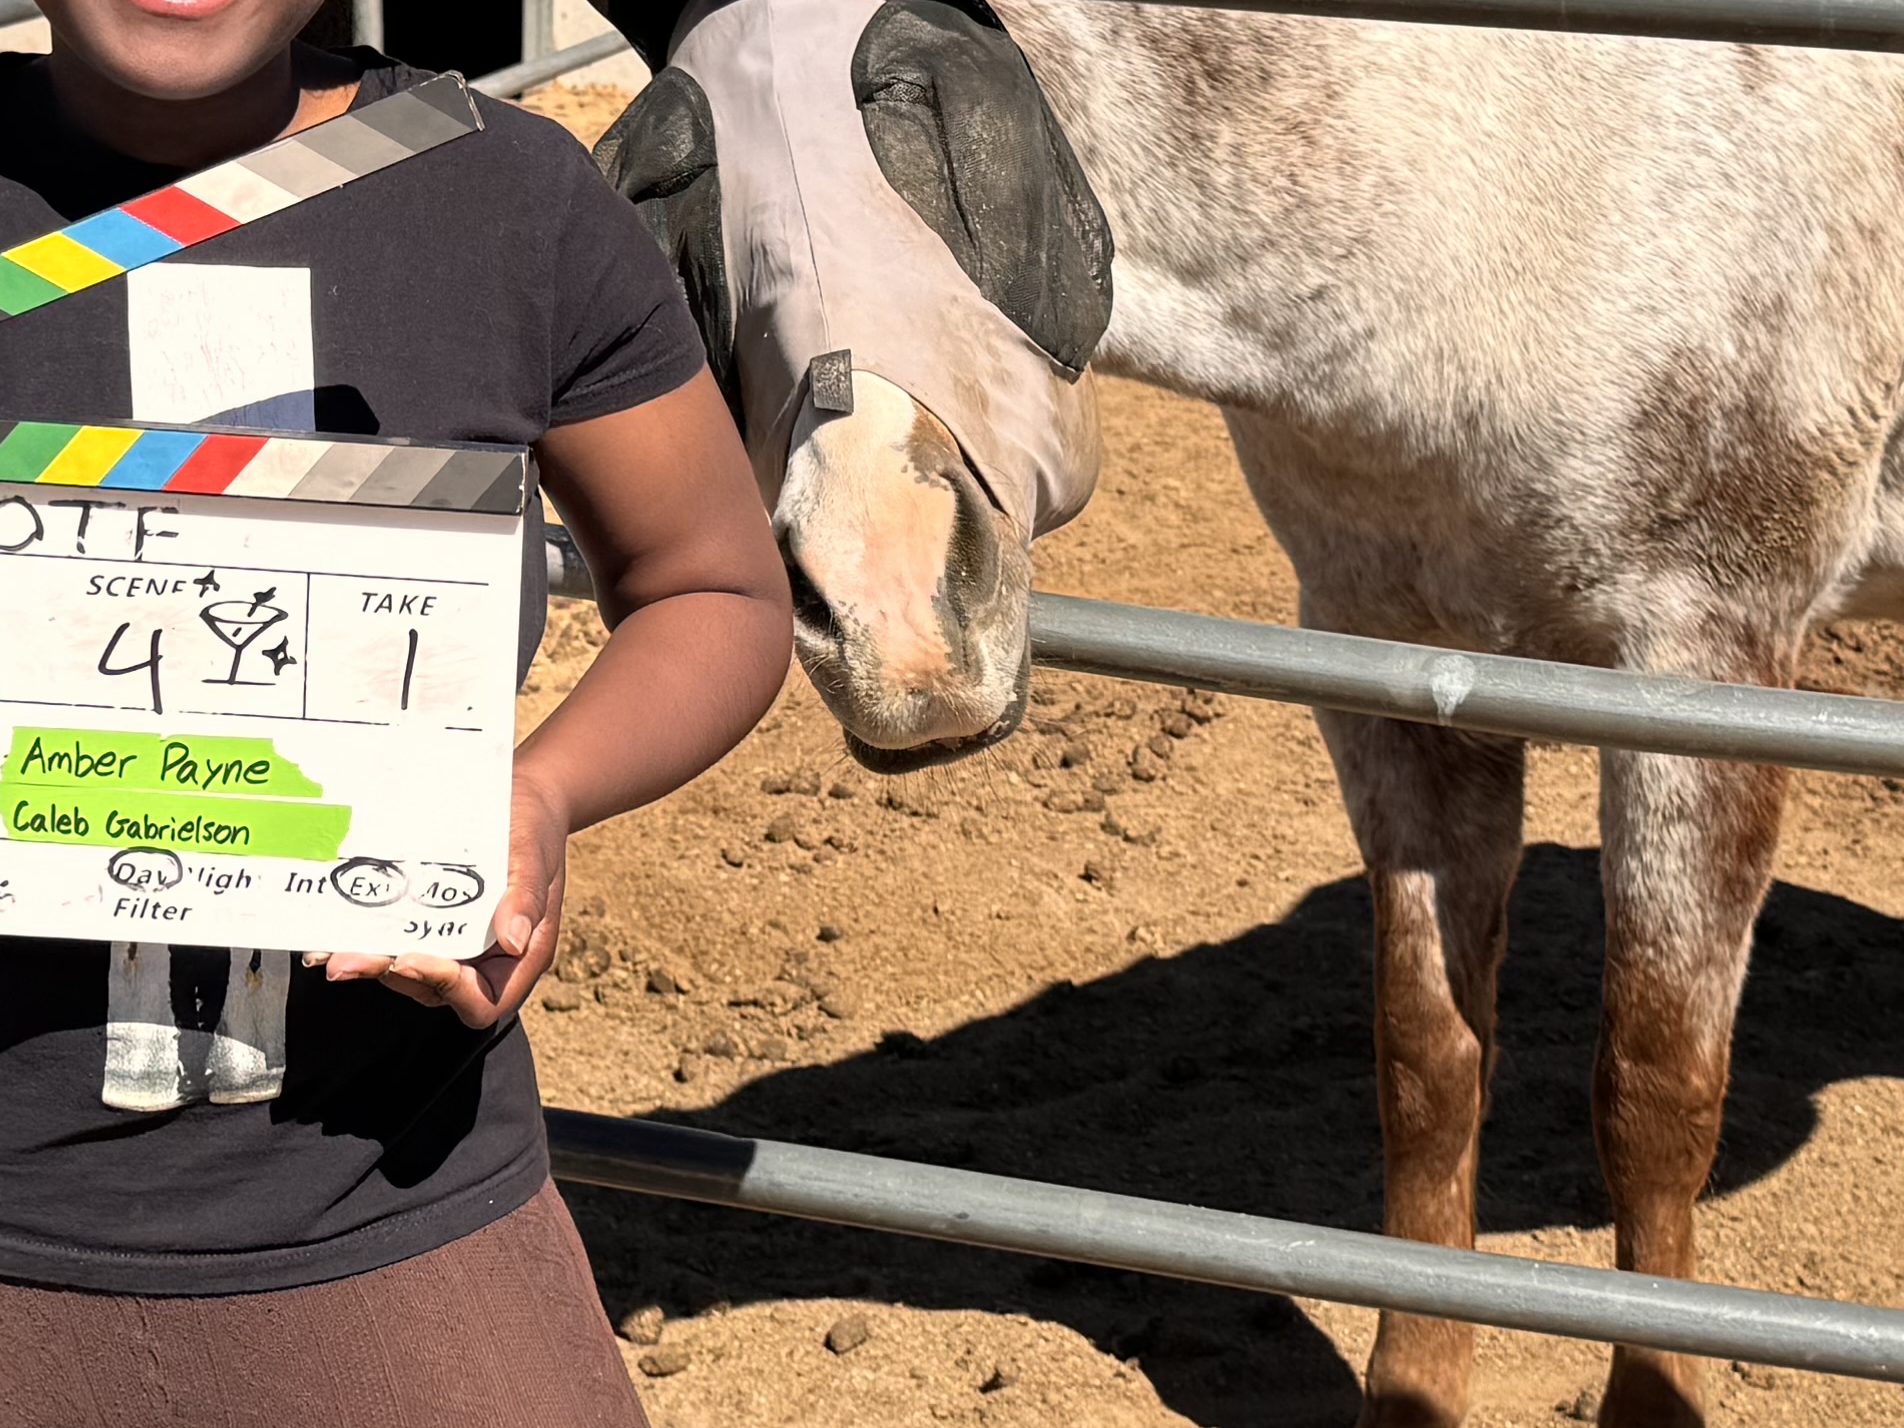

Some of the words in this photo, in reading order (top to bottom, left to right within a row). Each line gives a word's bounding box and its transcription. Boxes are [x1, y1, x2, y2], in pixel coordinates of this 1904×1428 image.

[86, 575, 187, 597] SCENE
[360, 592, 438, 616] TAKE
[98, 622, 163, 715] 4
[400, 628, 419, 710] 1
[20, 736, 138, 778] Amber
[160, 741, 271, 790] Payne
[13, 800, 90, 837] Caleb
[105, 809, 251, 846] Gabrielson
[285, 872, 327, 895] Int
[349, 876, 391, 897] Ex
[112, 897, 194, 922] Filter
